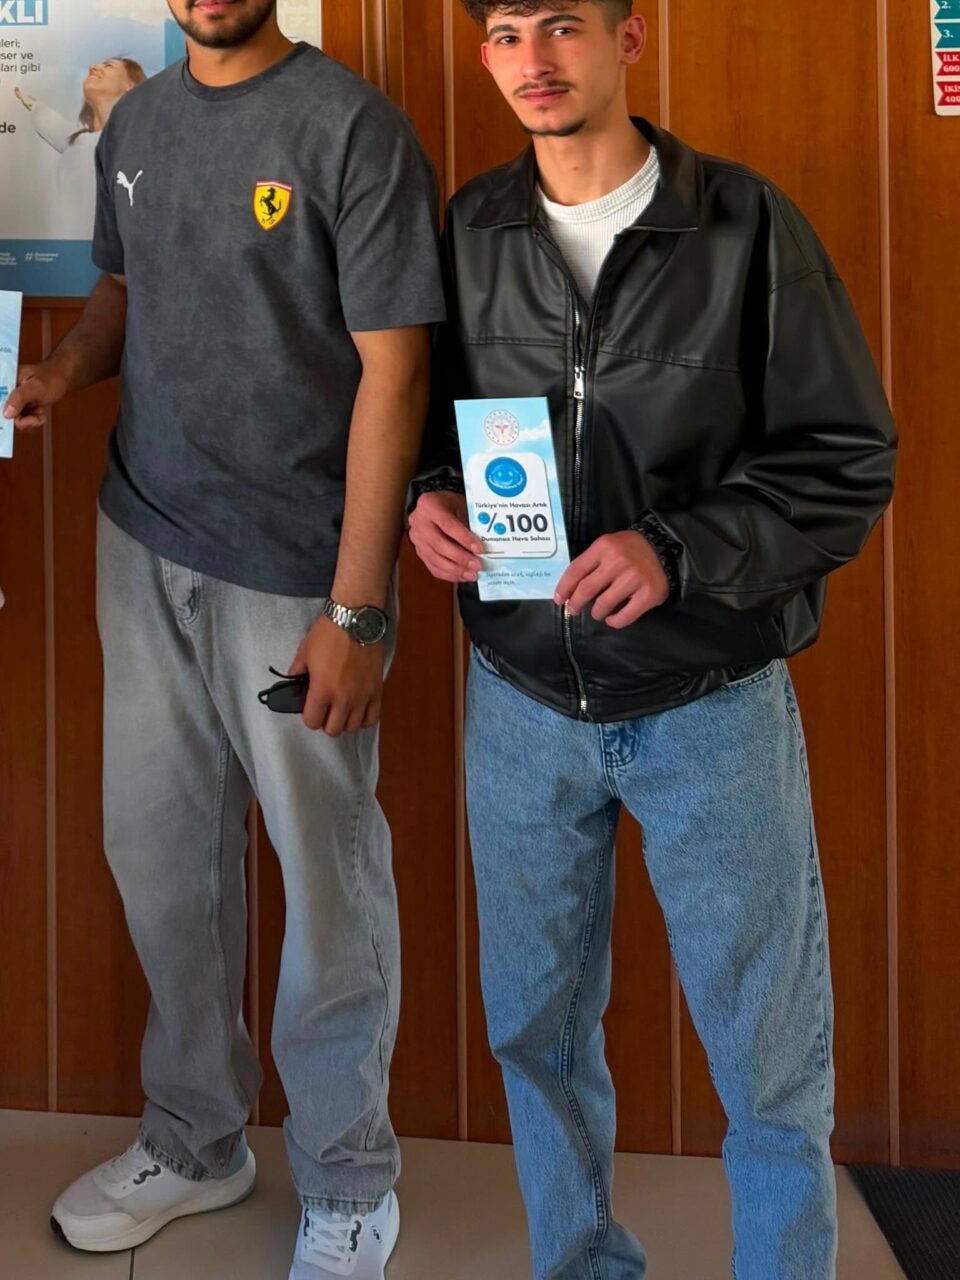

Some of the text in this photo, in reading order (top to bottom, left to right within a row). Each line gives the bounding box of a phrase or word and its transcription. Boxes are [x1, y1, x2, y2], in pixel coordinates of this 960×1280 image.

[941, 1, 951, 9] 2.
[943, 29, 954, 38] 3.
[21, 52, 34, 60] ve
[20, 63, 41, 74] gibi
